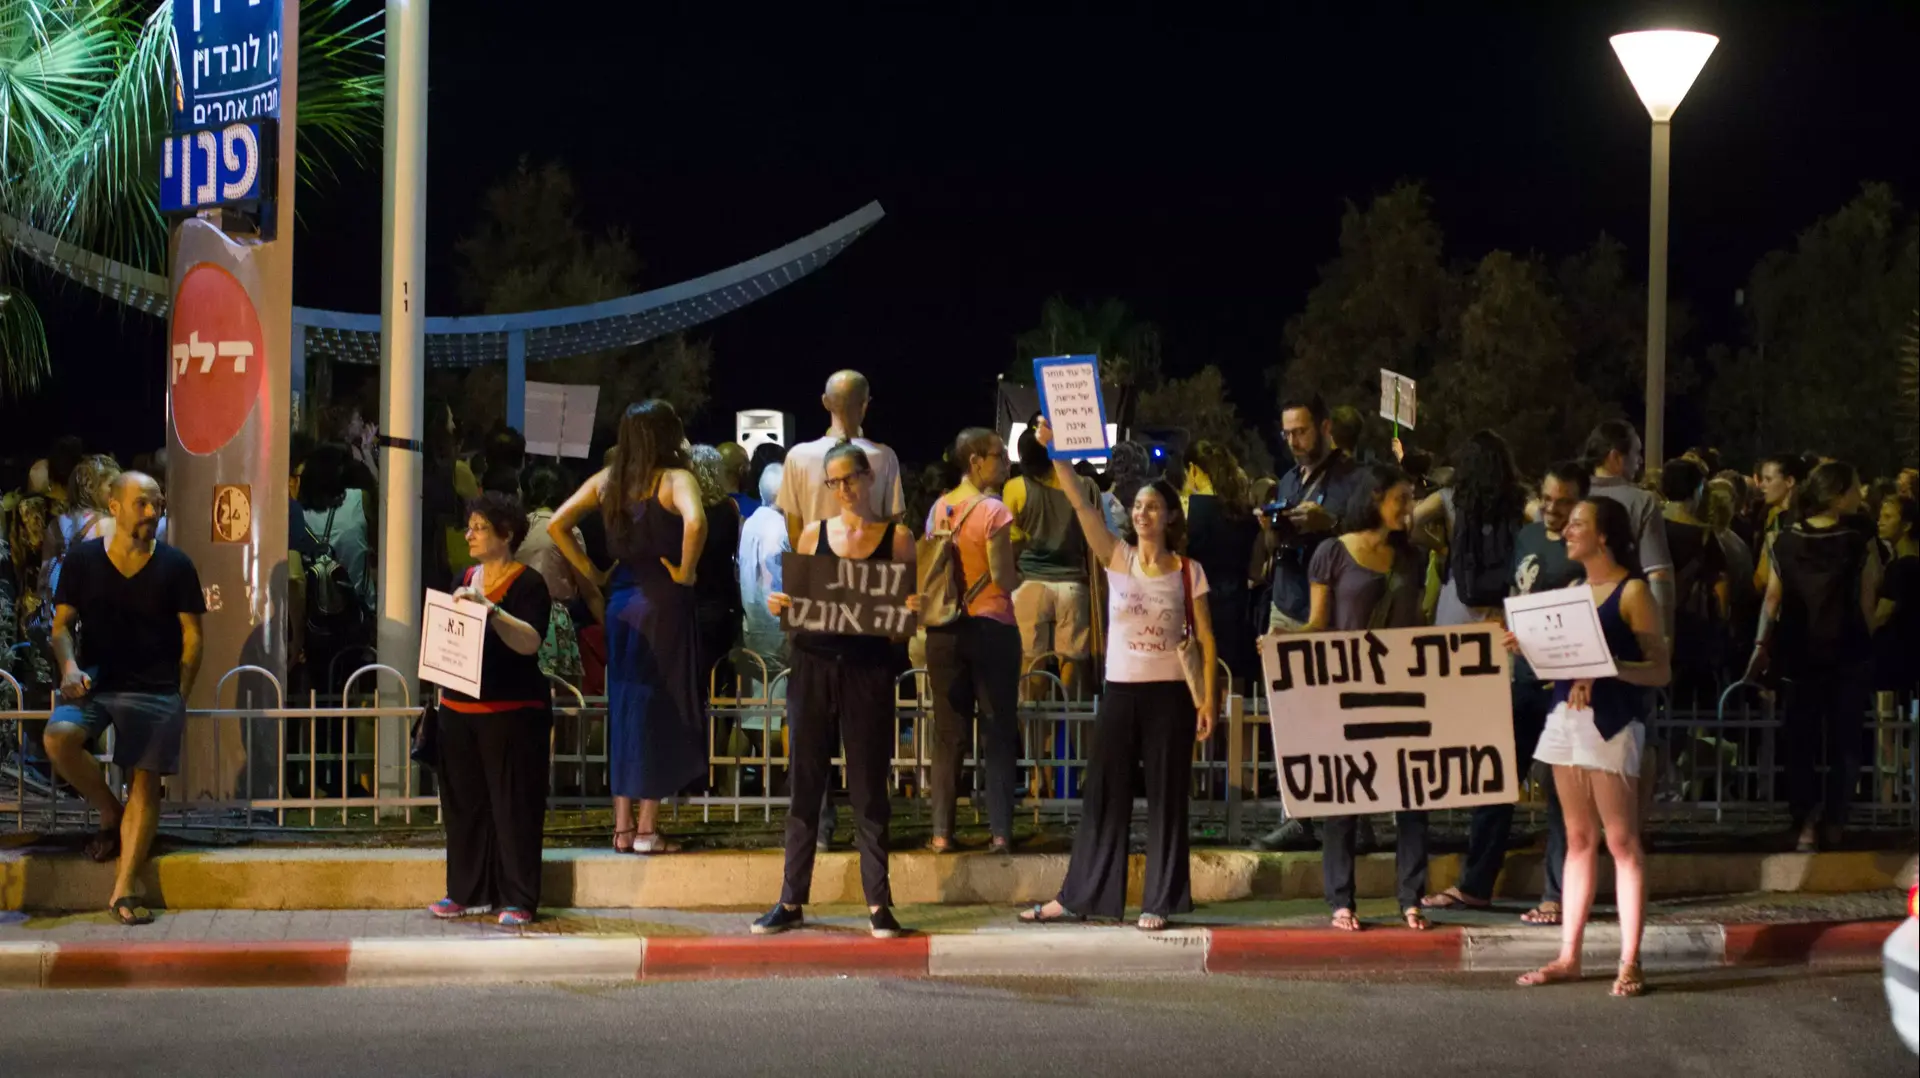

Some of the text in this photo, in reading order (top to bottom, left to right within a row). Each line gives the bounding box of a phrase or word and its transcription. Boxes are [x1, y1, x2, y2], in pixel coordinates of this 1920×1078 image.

[193, 30, 278, 90] גן לונדון
[193, 87, 278, 125] חברת אתרים
[164, 123, 258, 206] פנוי
[172, 330, 254, 385] דלק
[1054, 406, 1094, 417] אף אישה
[1077, 392, 1089, 401] של
[826, 558, 906, 597] זנות
[787, 596, 912, 633] זה אונס
[1272, 631, 1501, 691] בית זונות
[1282, 744, 1505, 809] מתקן אונס
